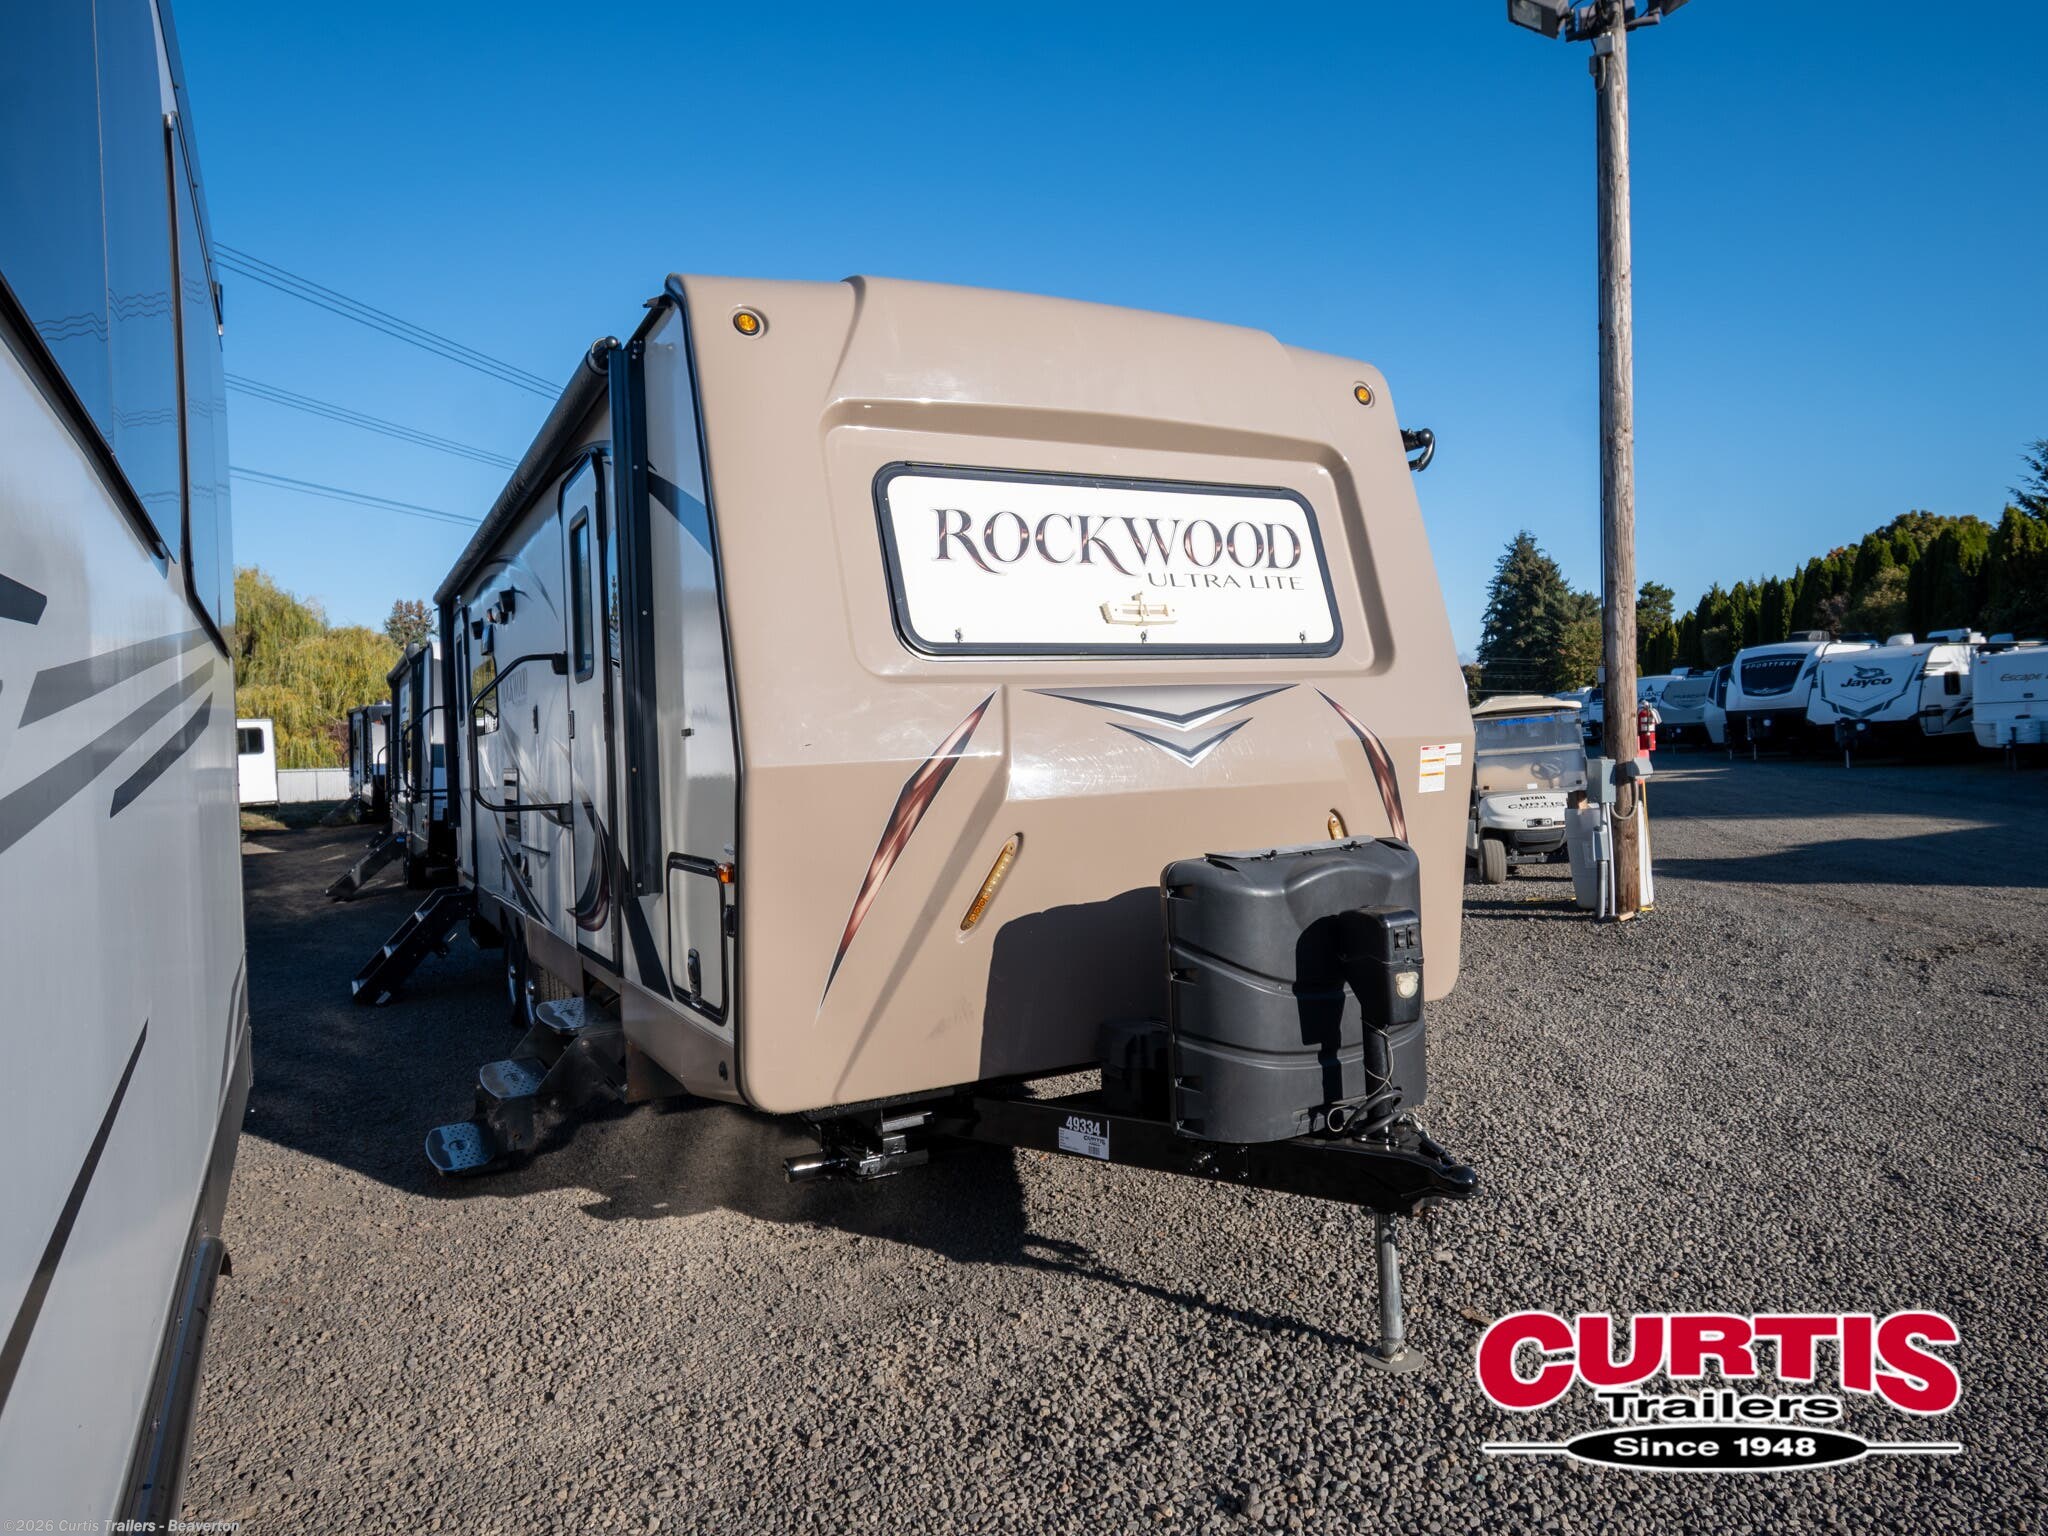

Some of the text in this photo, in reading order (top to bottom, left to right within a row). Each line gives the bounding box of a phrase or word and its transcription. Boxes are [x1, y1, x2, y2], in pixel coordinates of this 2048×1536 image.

[929, 506, 1302, 577] ROCKWOOD
[1147, 572, 1304, 591] ULTRA LITE
[1840, 677, 1893, 688] Jayco
[2000, 673, 2042, 682] Escape
[1066, 1116, 1100, 1136] 49334
